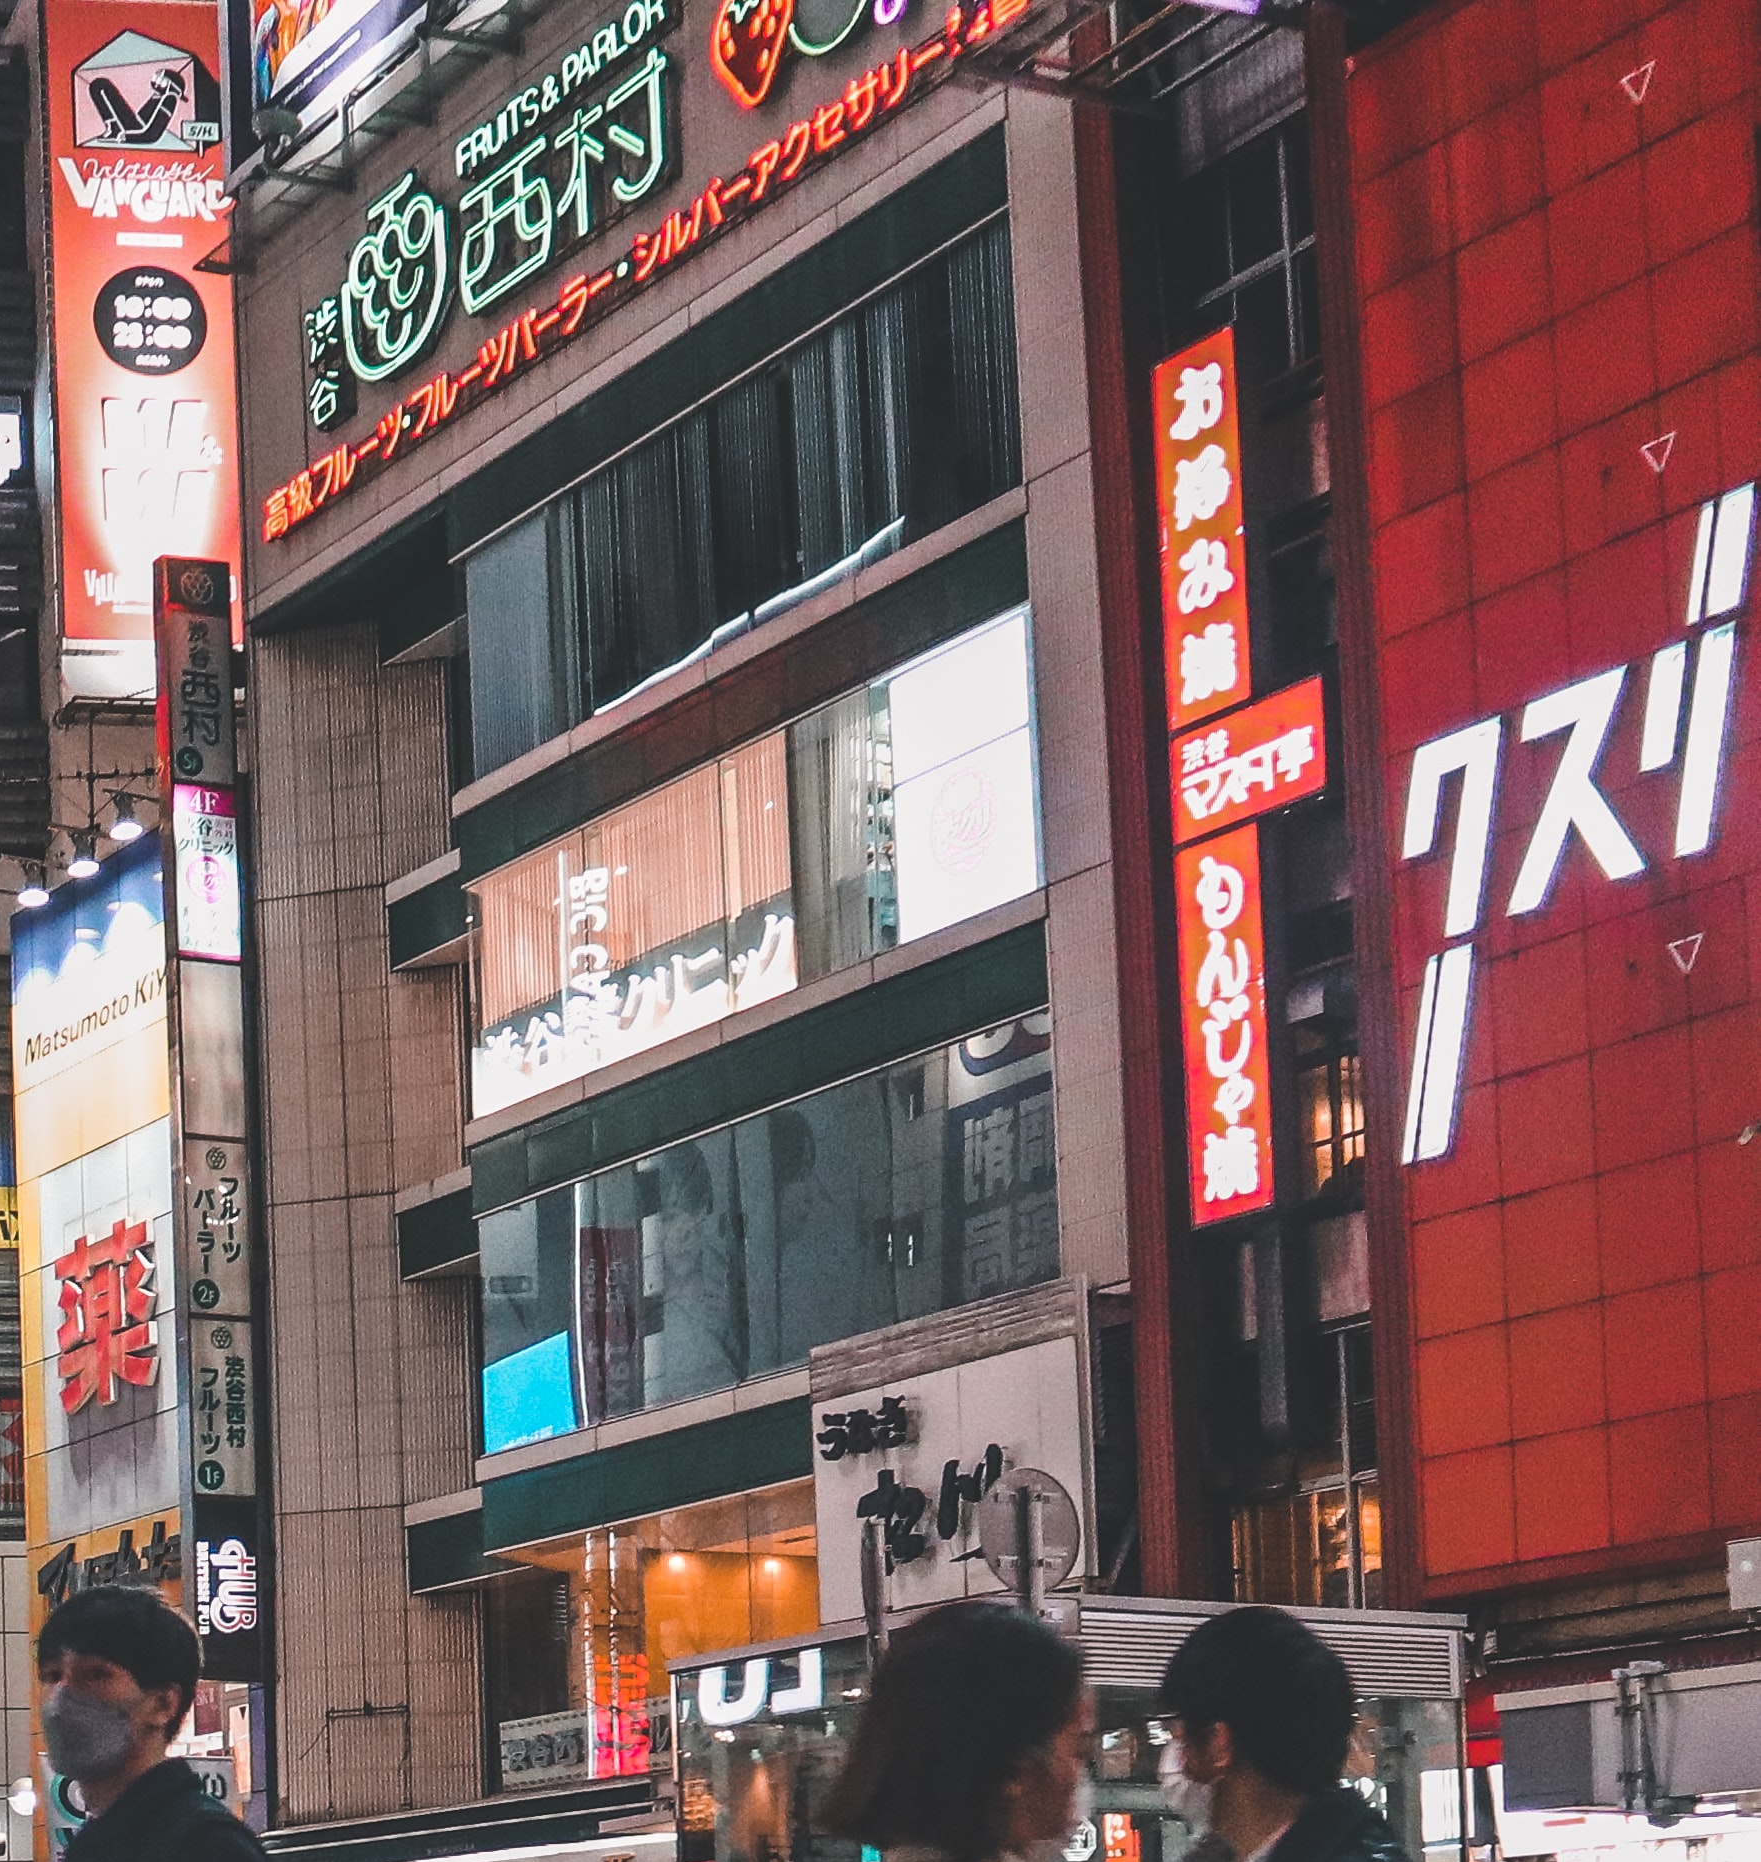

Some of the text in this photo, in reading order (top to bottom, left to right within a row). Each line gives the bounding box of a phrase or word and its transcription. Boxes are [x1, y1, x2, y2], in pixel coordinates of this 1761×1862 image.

[454, 90, 540, 178] FRUITS
[562, 0, 668, 98] PARLOR
[459, 48, 669, 315] 西村
[304, 298, 341, 428] 渋谷
[189, 790, 220, 812] 4F
[1401, 620, 1737, 938] クスリ
[178, 838, 236, 856] クリニック
[23, 996, 132, 1070] Matsumoto
[192, 1188, 216, 1276] パーラー
[218, 1176, 243, 1264] フルーツ
[54, 1217, 162, 1415] 薬
[197, 1284, 216, 1303] 2F
[198, 1366, 222, 1455] フルーツ
[224, 1355, 247, 1449] 渋谷西村
[196, 1605, 211, 1636] PUB
[209, 1537, 258, 1635] HUB
